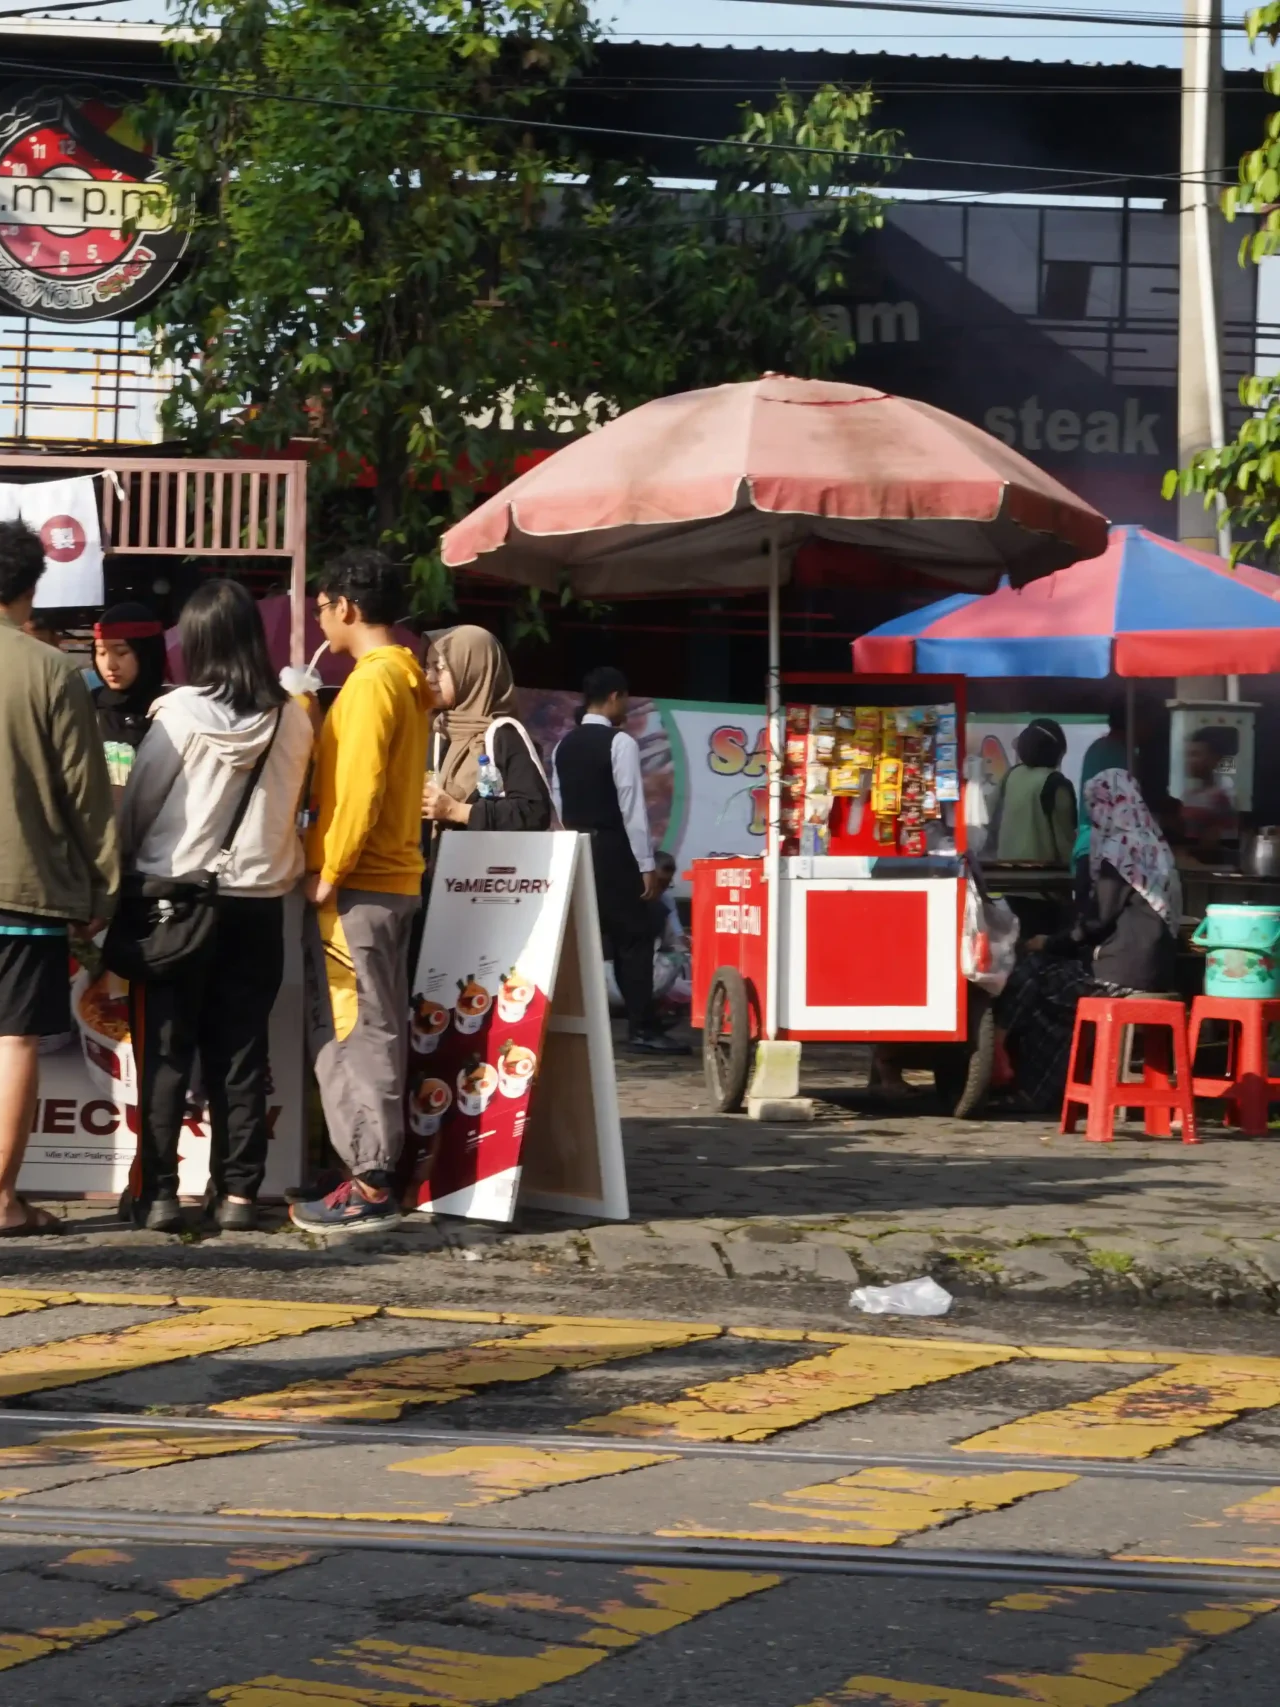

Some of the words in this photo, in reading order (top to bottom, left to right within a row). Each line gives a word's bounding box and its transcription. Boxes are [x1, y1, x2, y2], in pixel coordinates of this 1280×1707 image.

[31, 143, 47, 159] 11
[87, 243, 98, 260] 5
[44, 281, 93, 308] four
[983, 395, 1160, 455] steak
[445, 878, 554, 894] YaMIECURRY
